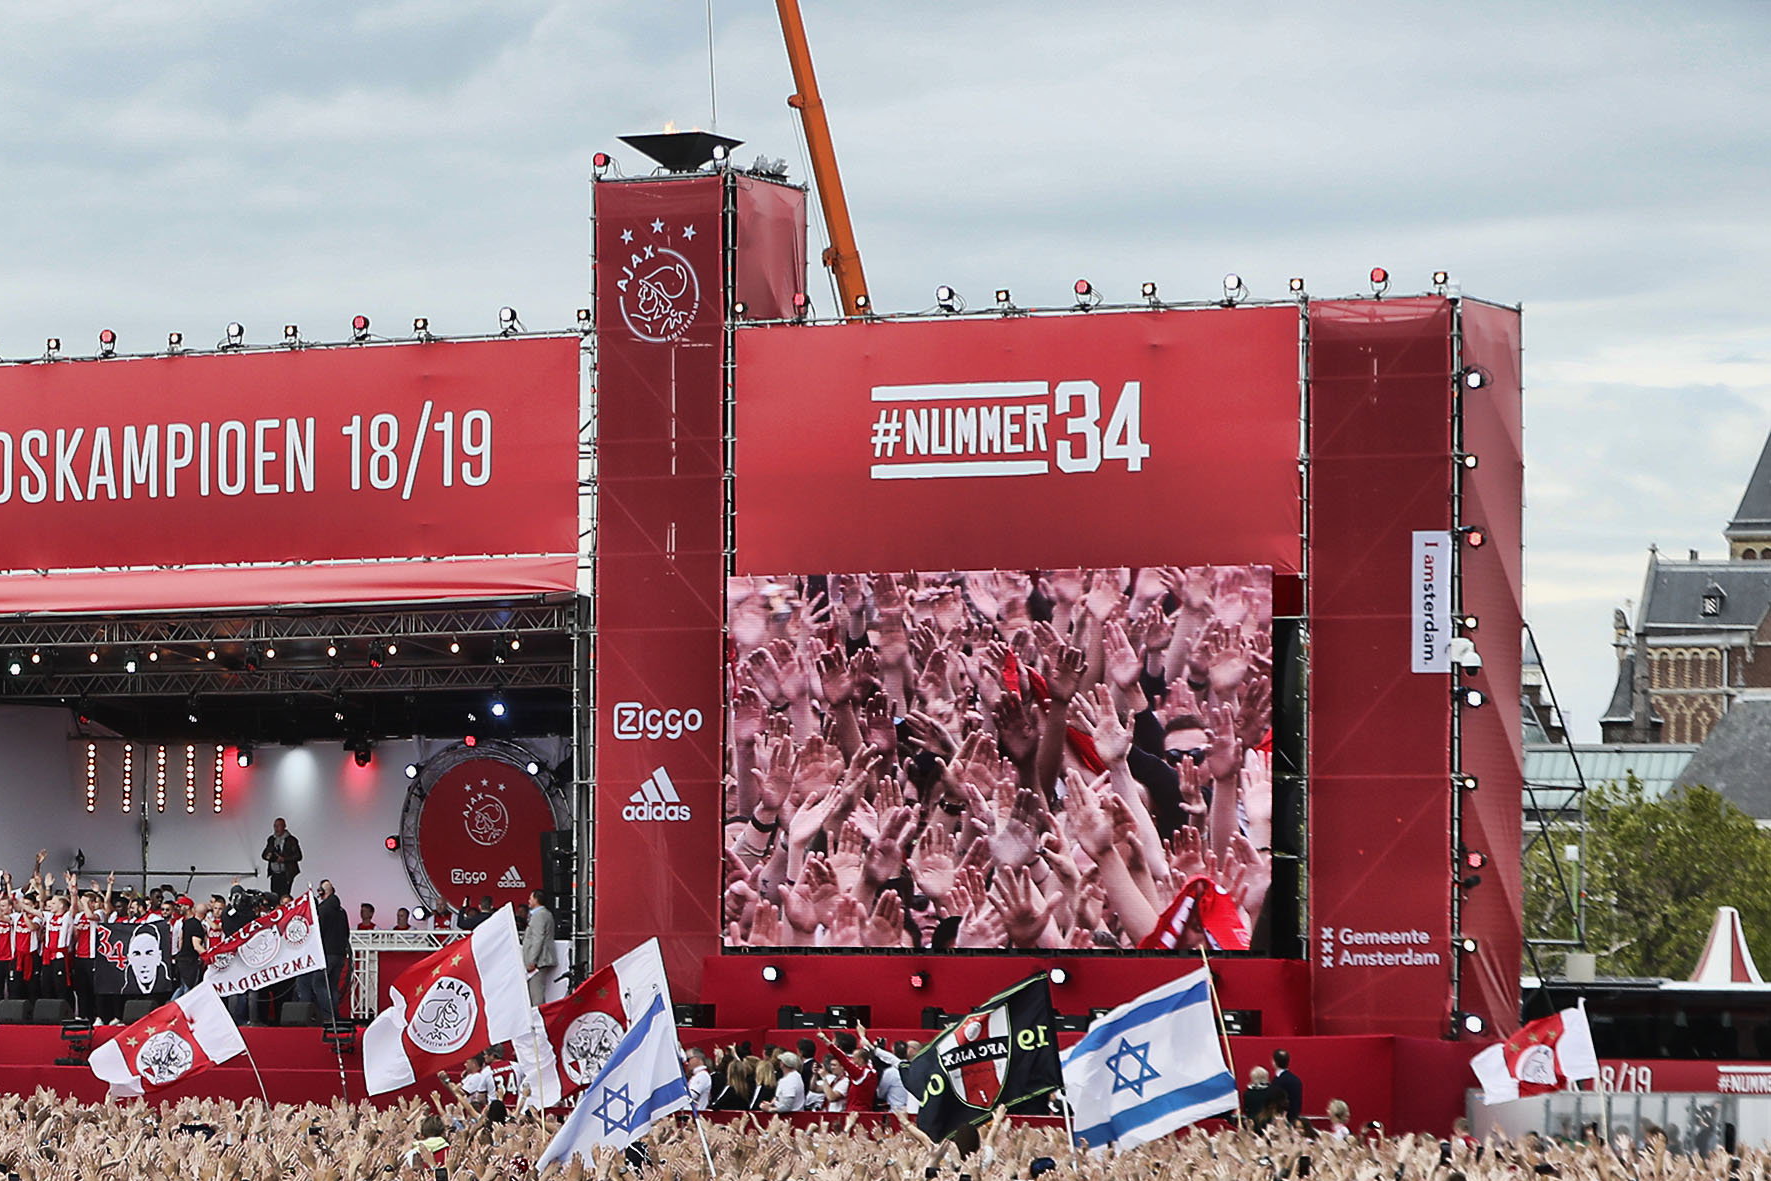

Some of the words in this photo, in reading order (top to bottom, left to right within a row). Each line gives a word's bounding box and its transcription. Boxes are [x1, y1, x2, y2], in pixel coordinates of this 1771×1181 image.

[616, 245, 655, 292] AJAX
[665, 302, 700, 342] AMSTERDAM
[341, 399, 493, 500] 18/19
[462, 792, 485, 818] AJAX
[621, 801, 692, 821] adidas
[497, 879, 526, 889] adidas
[97, 923, 128, 971] 34
[1339, 927, 1431, 944] Gemeente
[1339, 948, 1440, 967] Amsterdam
[494, 1073, 518, 1096] 34
